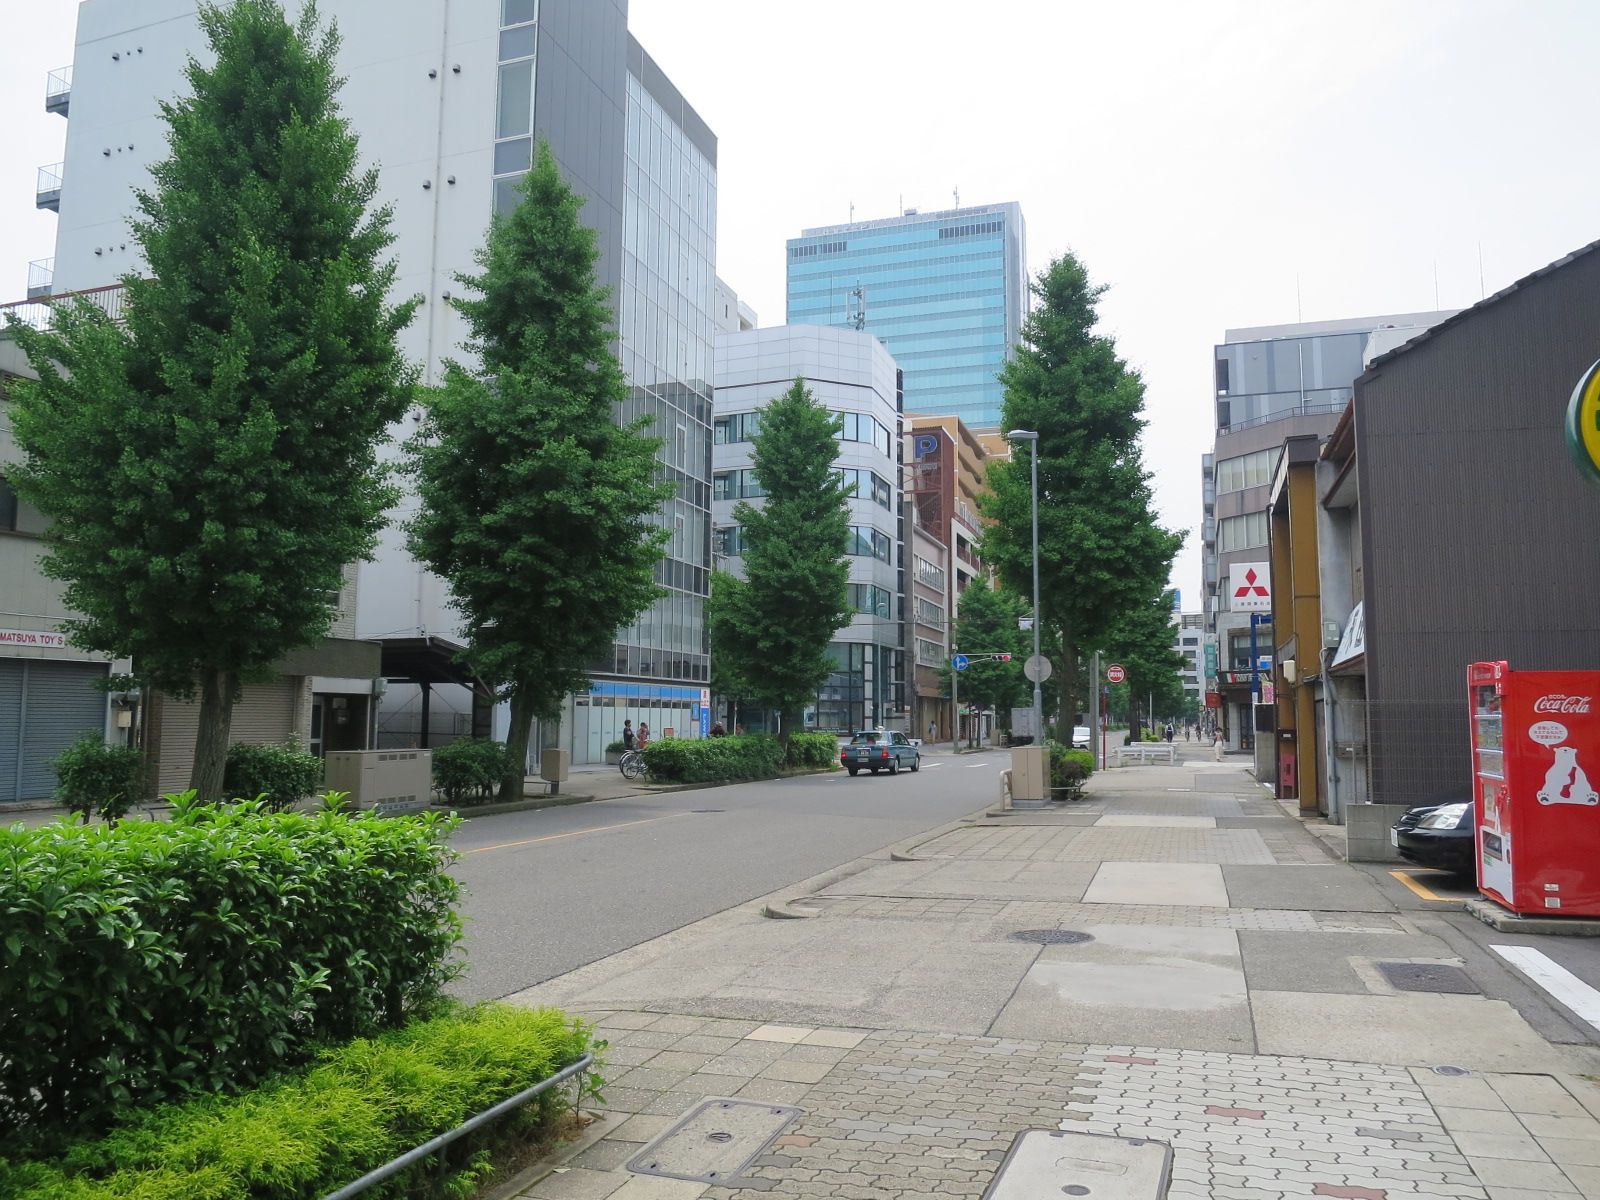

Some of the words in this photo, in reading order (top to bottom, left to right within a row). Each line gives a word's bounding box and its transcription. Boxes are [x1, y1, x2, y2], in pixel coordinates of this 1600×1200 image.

[914, 435, 938, 462] P
[0, 632, 37, 643] MATSUYA
[1534, 696, 1592, 713] Coca-Cola
